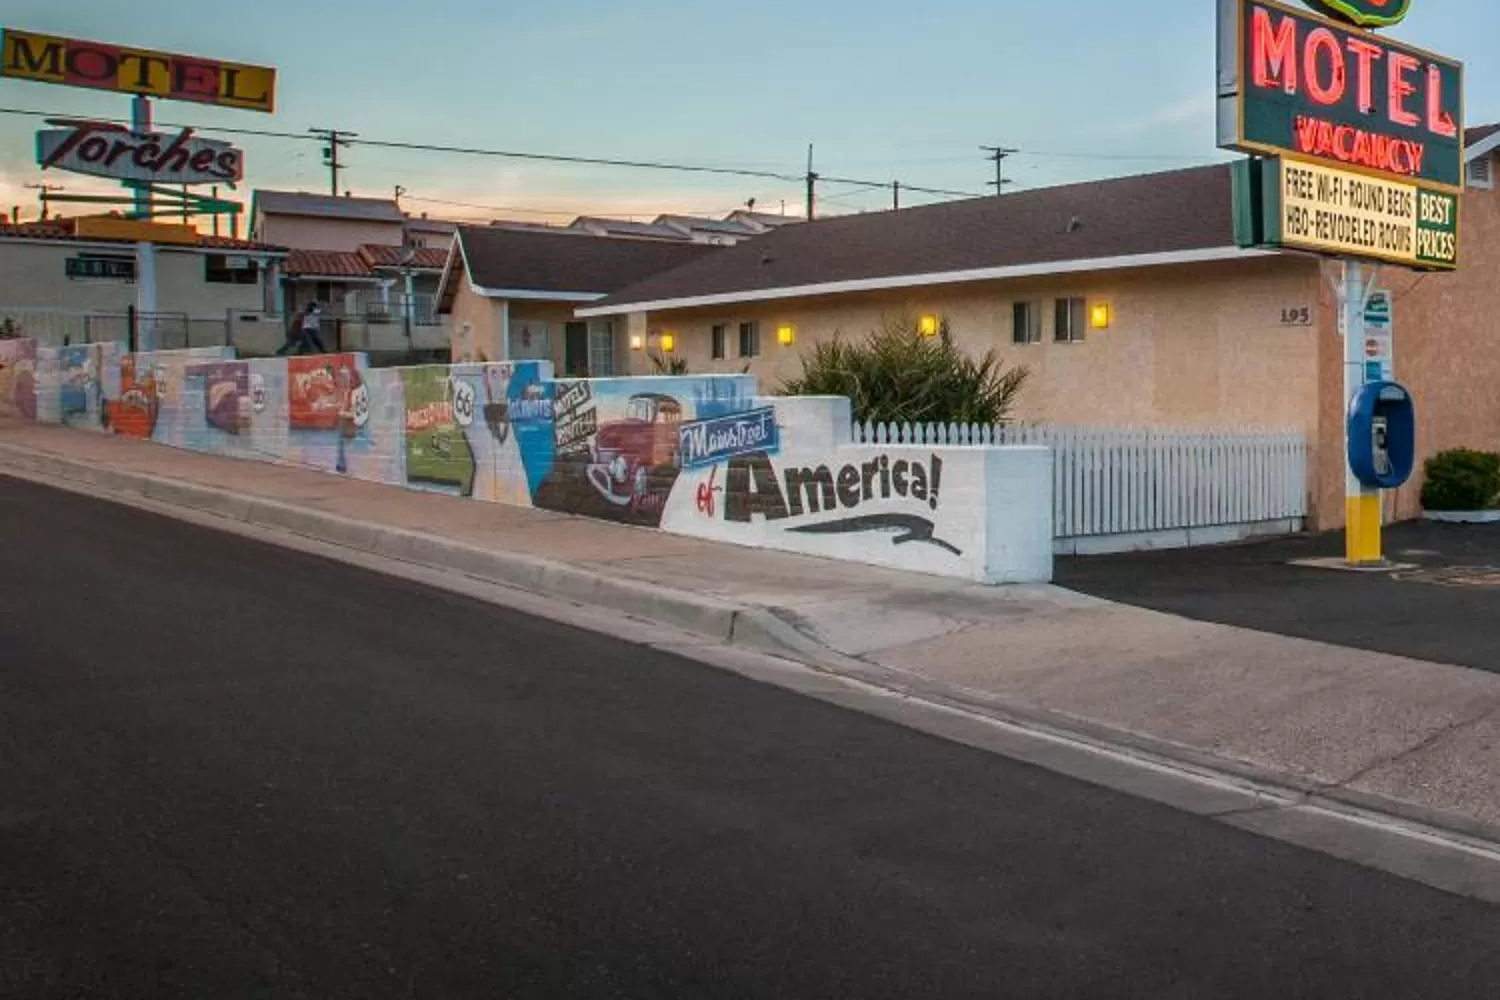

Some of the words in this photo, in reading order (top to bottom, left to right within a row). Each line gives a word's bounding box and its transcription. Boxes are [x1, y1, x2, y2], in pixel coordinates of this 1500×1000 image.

[7, 36, 268, 102] MOTEL
[1252, 5, 1457, 138] MOTEL
[42, 118, 238, 190] Torches
[1295, 115, 1424, 174] VACANCY
[1286, 167, 1313, 199] FREE
[1387, 187, 1412, 218] BEDS
[1420, 192, 1453, 225] BEST
[1378, 220, 1411, 252] ROOMS
[1417, 227, 1455, 260] PRICES
[1281, 307, 1309, 322] 195
[455, 388, 473, 417] 66
[696, 463, 723, 517] of
[724, 450, 943, 522] America!
